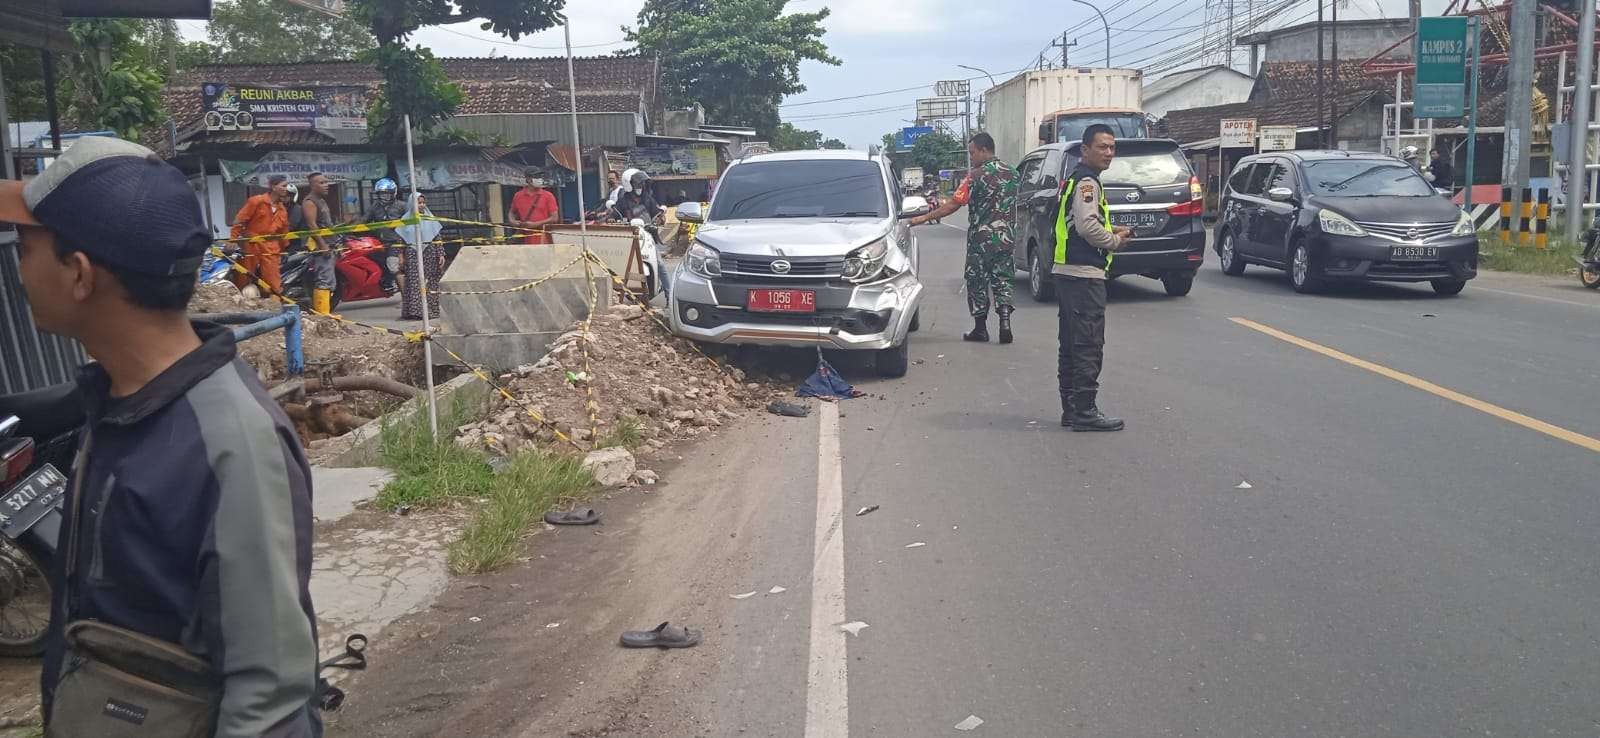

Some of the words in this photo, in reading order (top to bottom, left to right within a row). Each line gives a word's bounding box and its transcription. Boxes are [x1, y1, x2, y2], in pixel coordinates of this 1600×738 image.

[1422, 40, 1455, 54] KAMPUS
[1456, 40, 1463, 54] 2
[240, 89, 274, 100] REUNI
[276, 90, 314, 100] AKBAR
[250, 104, 266, 113] SMA
[267, 104, 296, 113] KRISTEN
[297, 104, 315, 112] CEPU
[750, 291, 757, 303] K
[768, 291, 791, 304] 1056
[801, 292, 813, 305] XE
[6, 484, 37, 510] 5217
